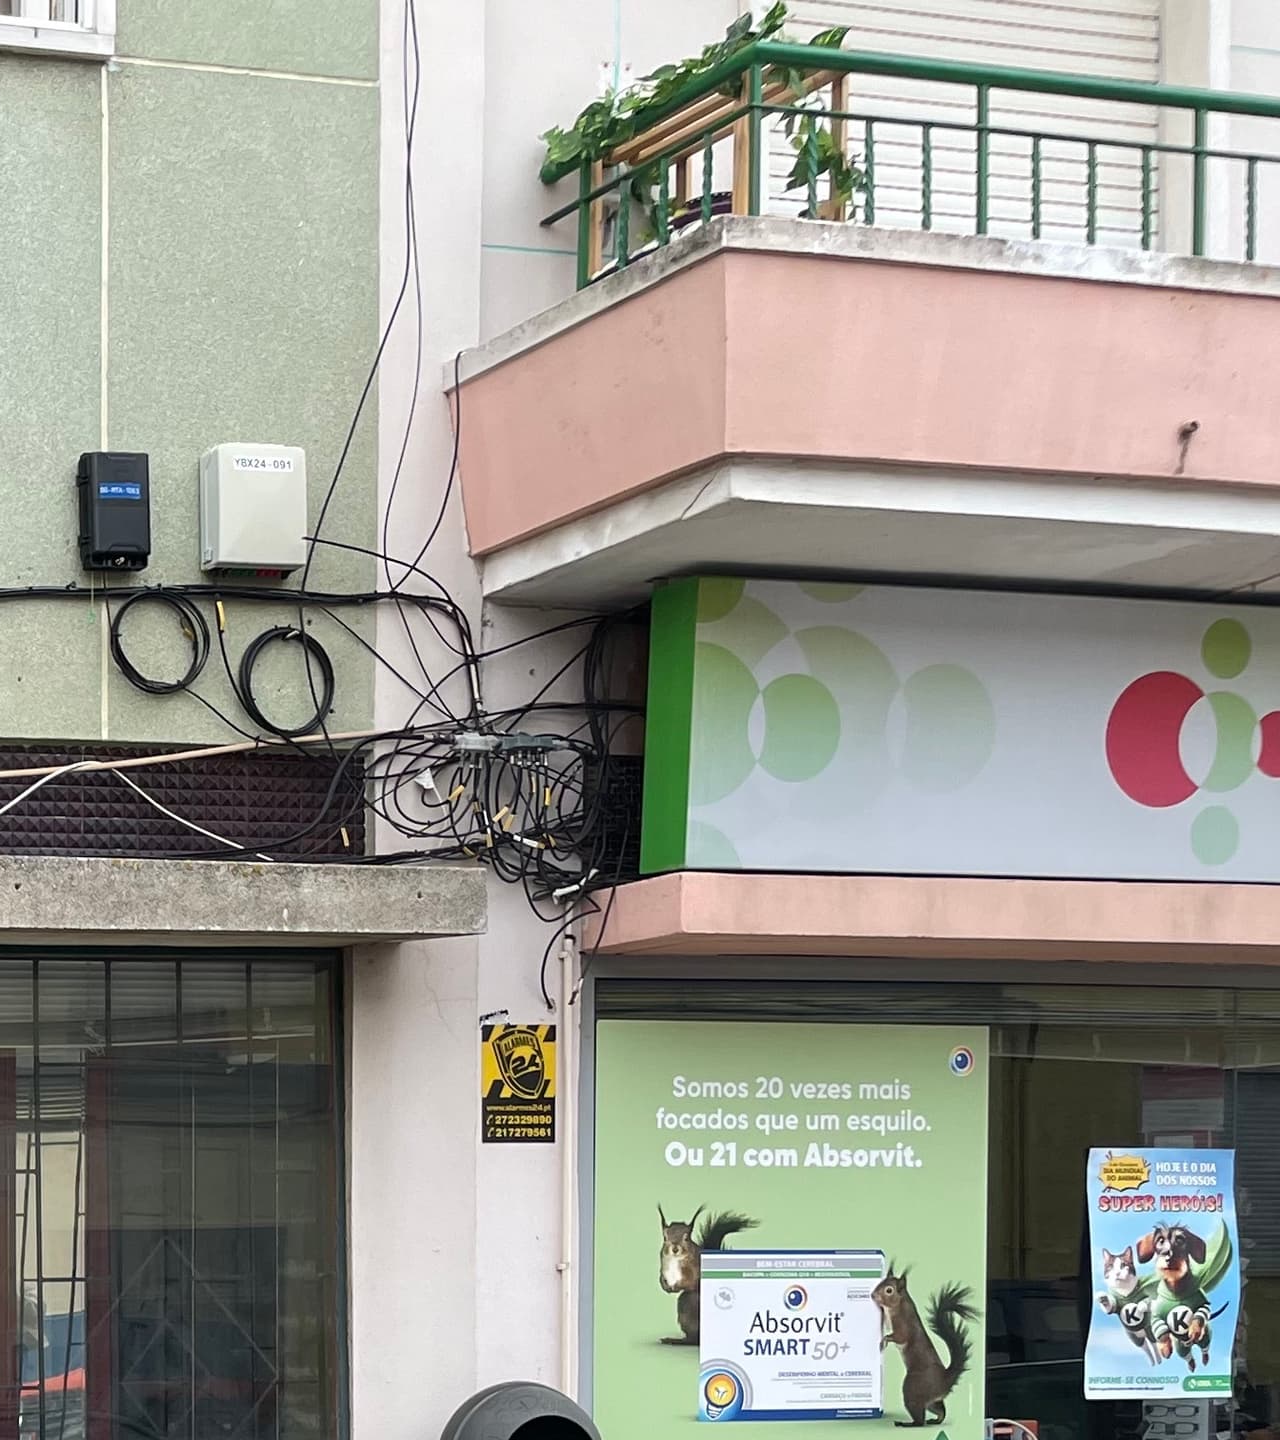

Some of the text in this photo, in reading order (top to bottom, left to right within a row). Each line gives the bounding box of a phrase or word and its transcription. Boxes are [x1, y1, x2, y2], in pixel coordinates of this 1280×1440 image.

[234, 458, 291, 469] YBX24-091
[672, 1075, 911, 1100] Somos 20 vezes mais
[656, 1107, 931, 1136] focados que um esquilo.
[664, 1141, 923, 1168] Ou 21 com Absorvit.
[1156, 1162, 1181, 1173] HOJE
[1190, 1163, 1197, 1172] O
[1200, 1163, 1216, 1172] DIA
[1156, 1175, 1217, 1185] DOS NOSSOS
[1098, 1194, 1156, 1212] SUPER
[749, 1310, 841, 1333] Absorvit
[1172, 1310, 1189, 1331] K
[743, 1338, 851, 1360] SMART 50+
